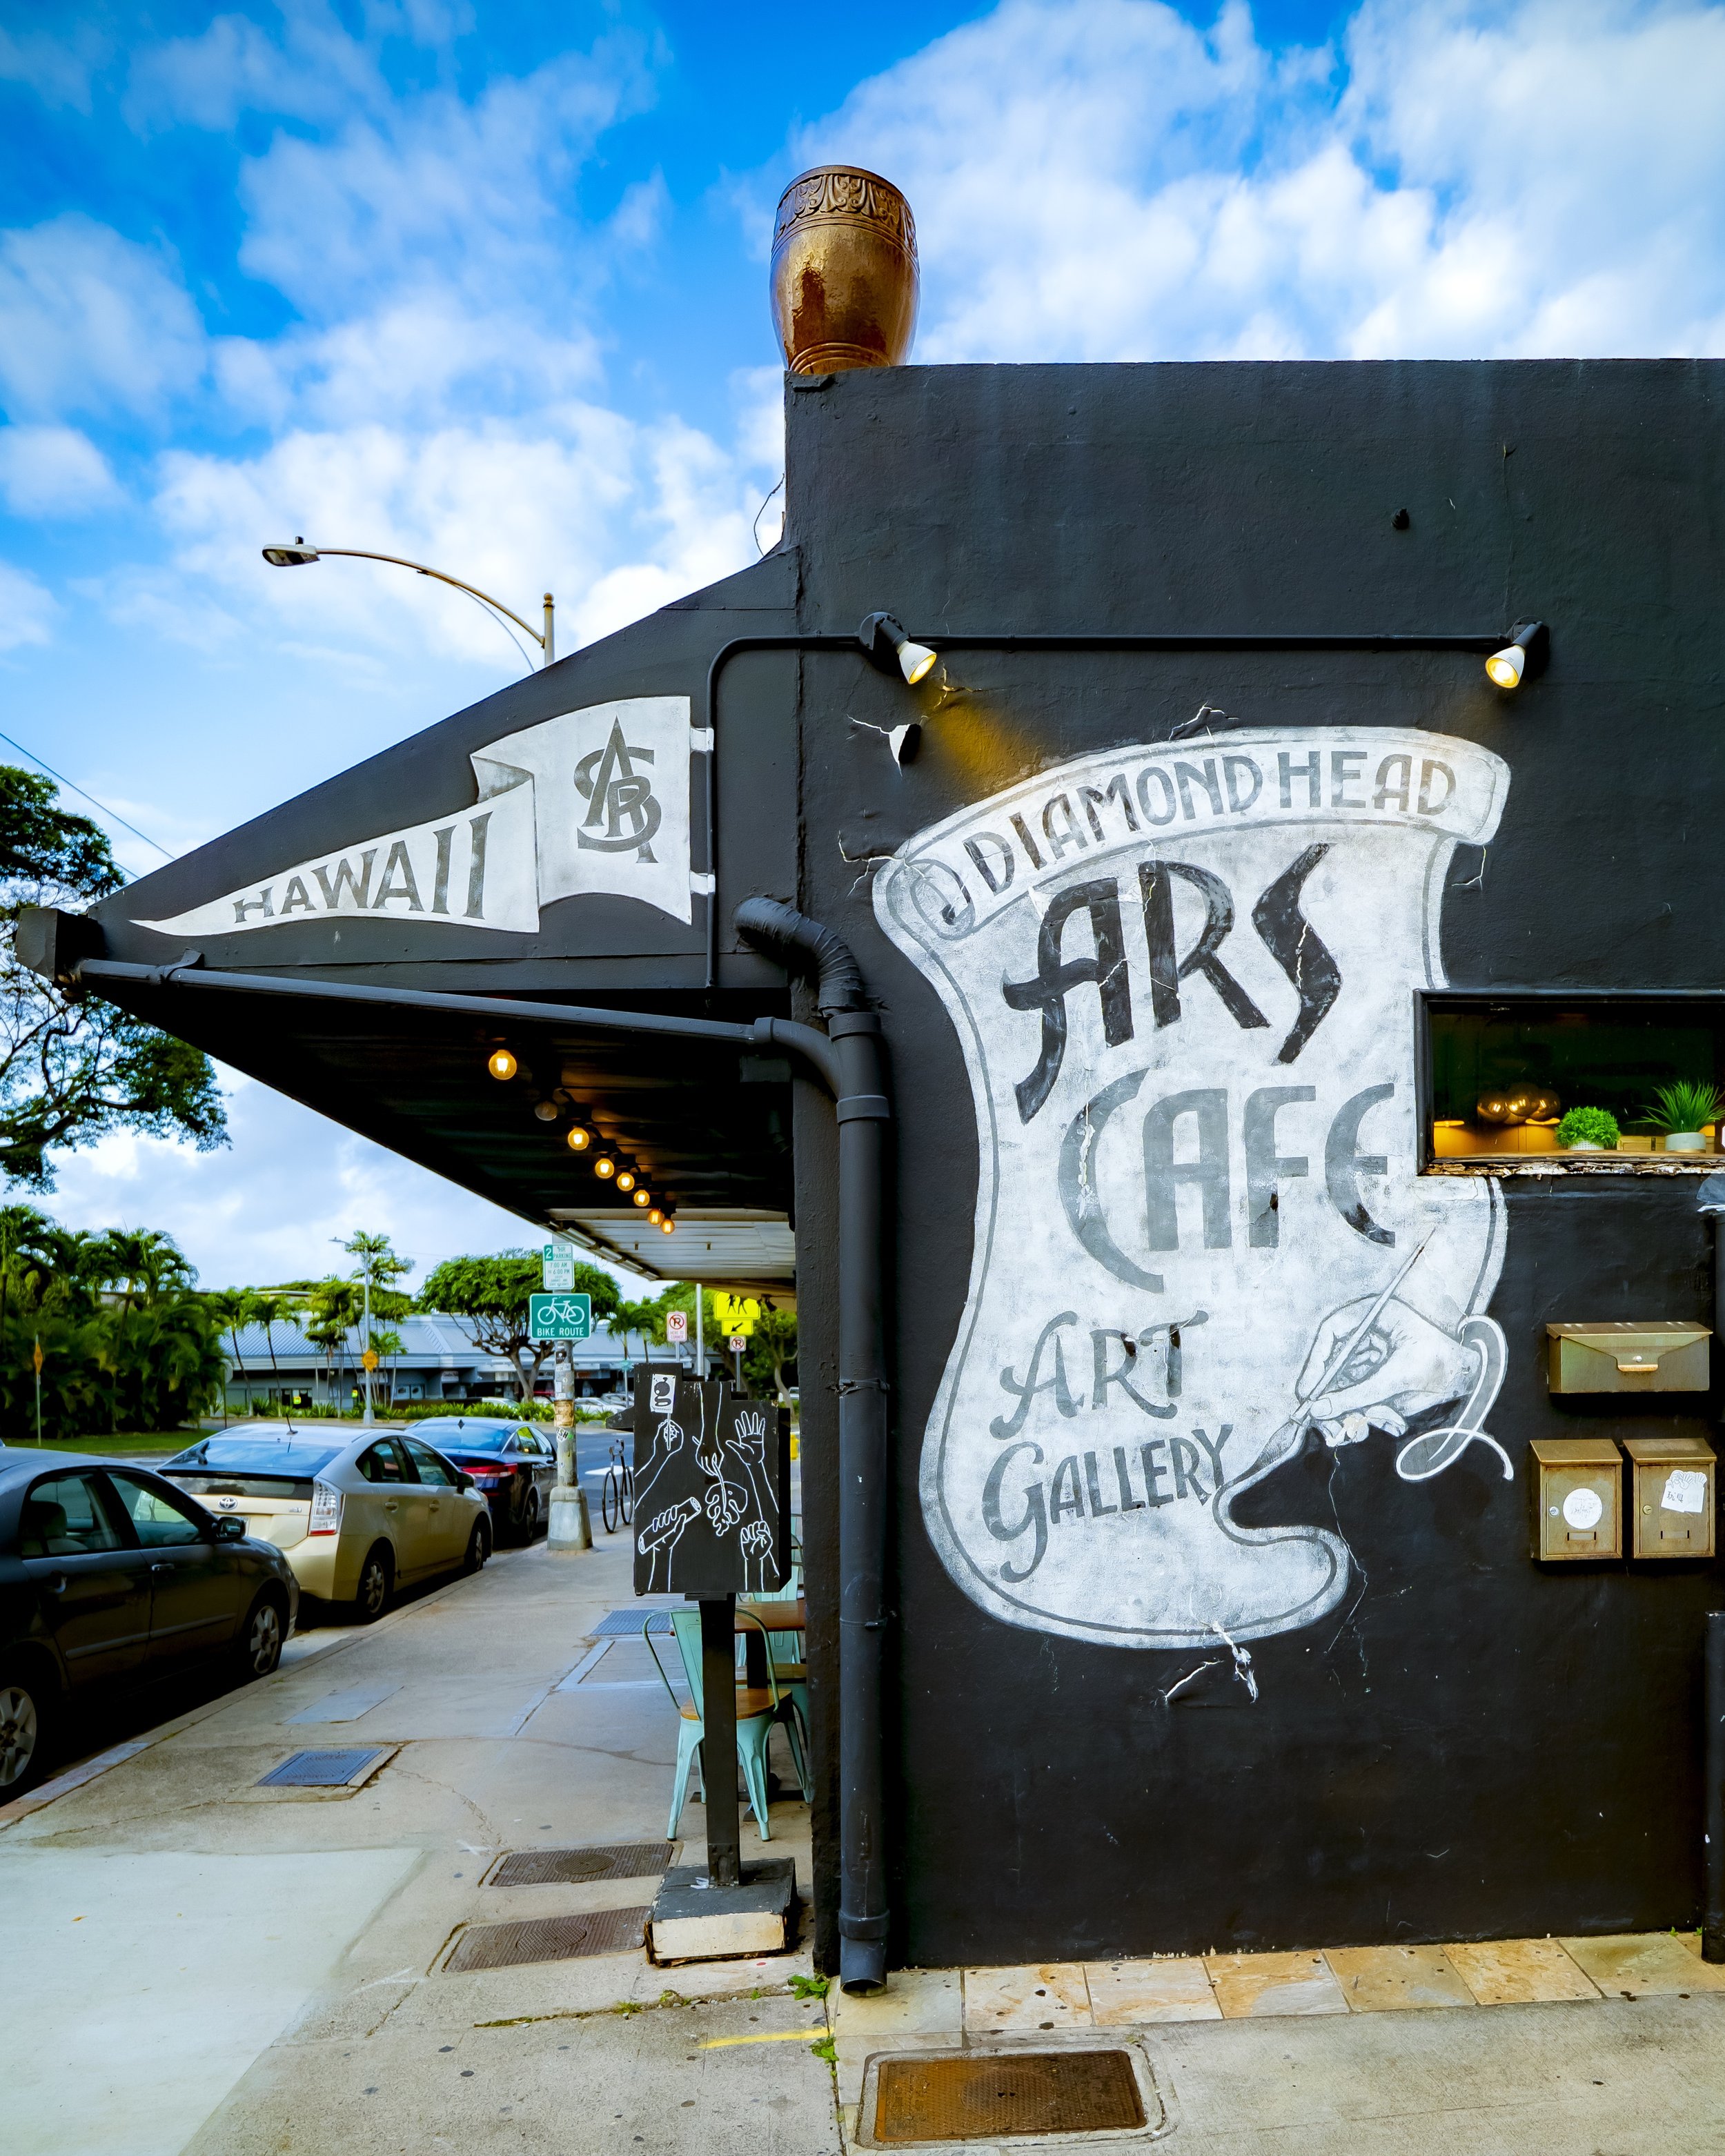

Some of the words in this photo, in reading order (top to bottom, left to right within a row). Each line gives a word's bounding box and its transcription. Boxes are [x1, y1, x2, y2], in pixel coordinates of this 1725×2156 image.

[232, 811, 494, 924] HAWAII
[963, 755, 1263, 896] DIAMOND
[1278, 751, 1457, 815] HEAD
[1002, 842, 1343, 1125] ARS
[1058, 1067, 1397, 1294] CAFE
[545, 1247, 552, 1259] 2
[537, 1327, 555, 1336] BIKE
[559, 1327, 584, 1336] ROUTE
[989, 1310, 1208, 1440] ART
[982, 1423, 1234, 1583] GALLERY
